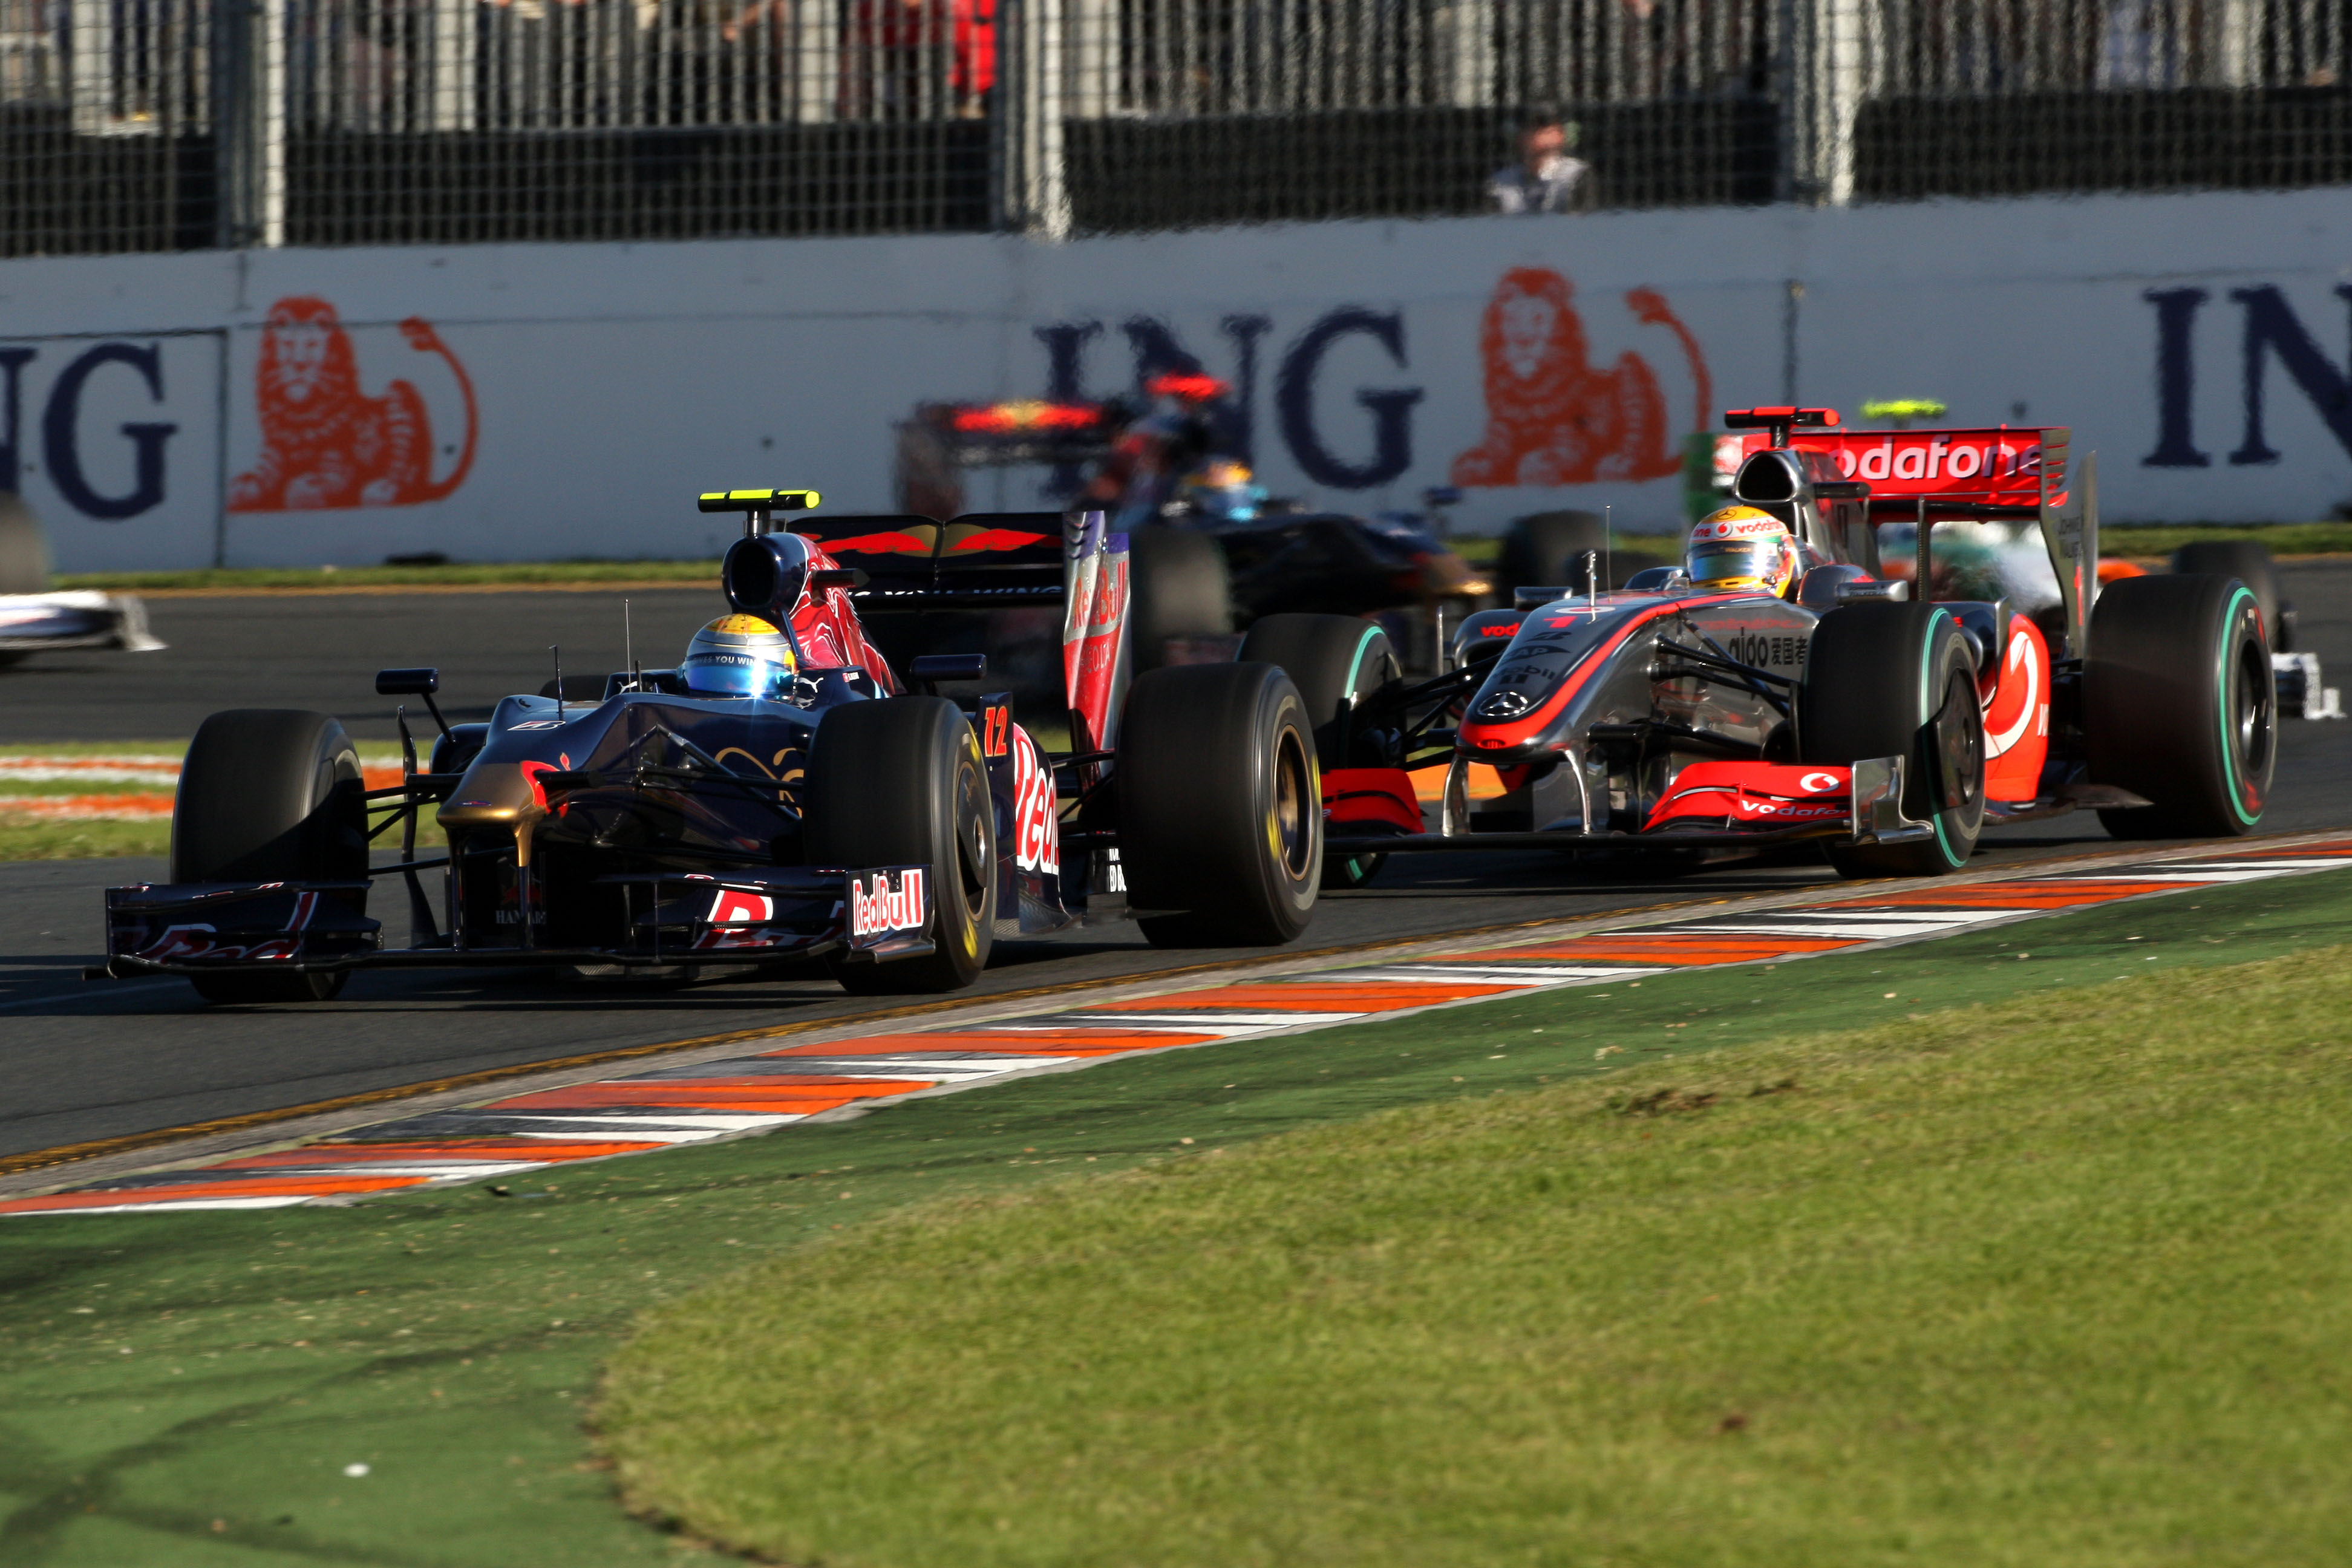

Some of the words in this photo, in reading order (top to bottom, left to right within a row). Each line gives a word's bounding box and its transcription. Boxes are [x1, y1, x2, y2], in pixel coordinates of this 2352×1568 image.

[1831, 434, 2041, 480] odafone
[1544, 616, 1578, 628] 1
[984, 705, 1008, 757] 12
